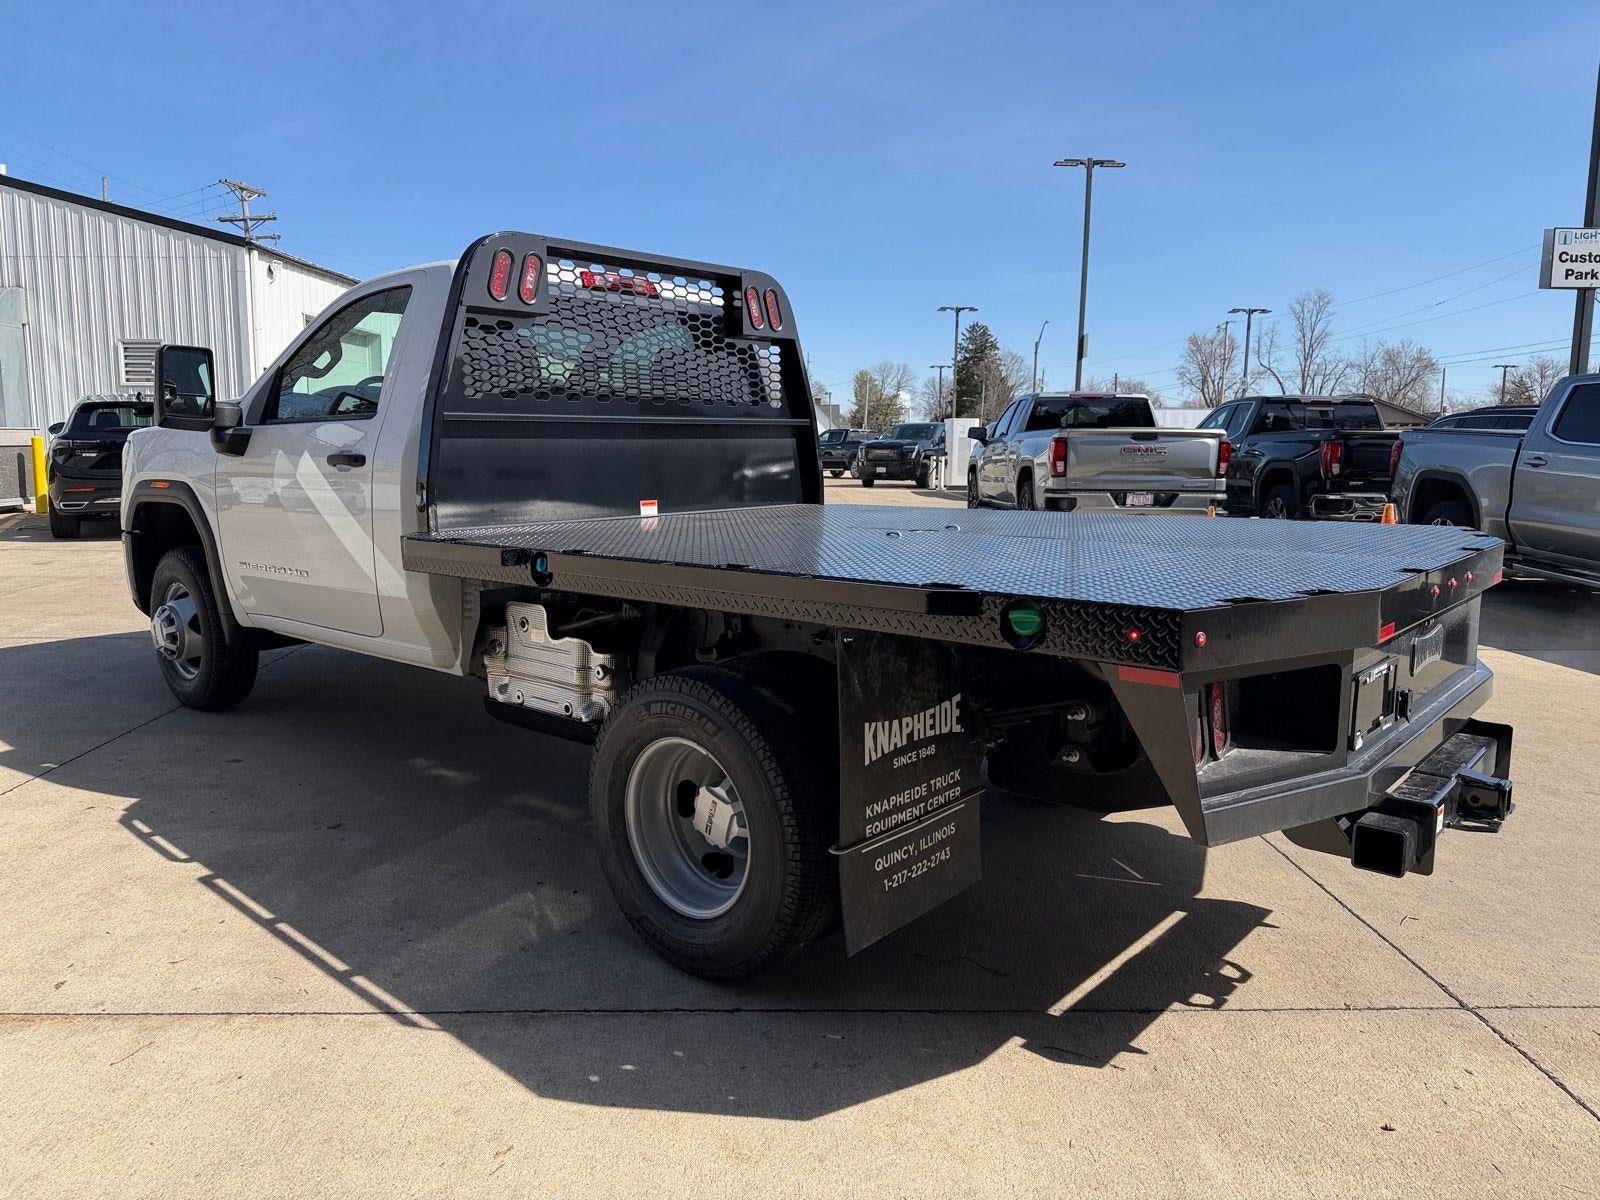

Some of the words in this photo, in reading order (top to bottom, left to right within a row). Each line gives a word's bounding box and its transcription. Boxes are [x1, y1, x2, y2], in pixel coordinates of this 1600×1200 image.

[1558, 251, 1600, 263] Custo
[1564, 268, 1599, 280] Park
[239, 562, 287, 574] SIERRA
[892, 751, 918, 769] SINCE
[918, 744, 936, 760] 1848
[865, 782, 928, 820] KNAPHEIDE
[930, 768, 961, 793] TRUCK
[865, 801, 925, 839] EQUIPMENT
[927, 786, 961, 812] CENTER
[874, 843, 918, 872] QUINCY,
[919, 822, 956, 852] ILLINOIS
[883, 846, 951, 892] 1-217-222-2743
